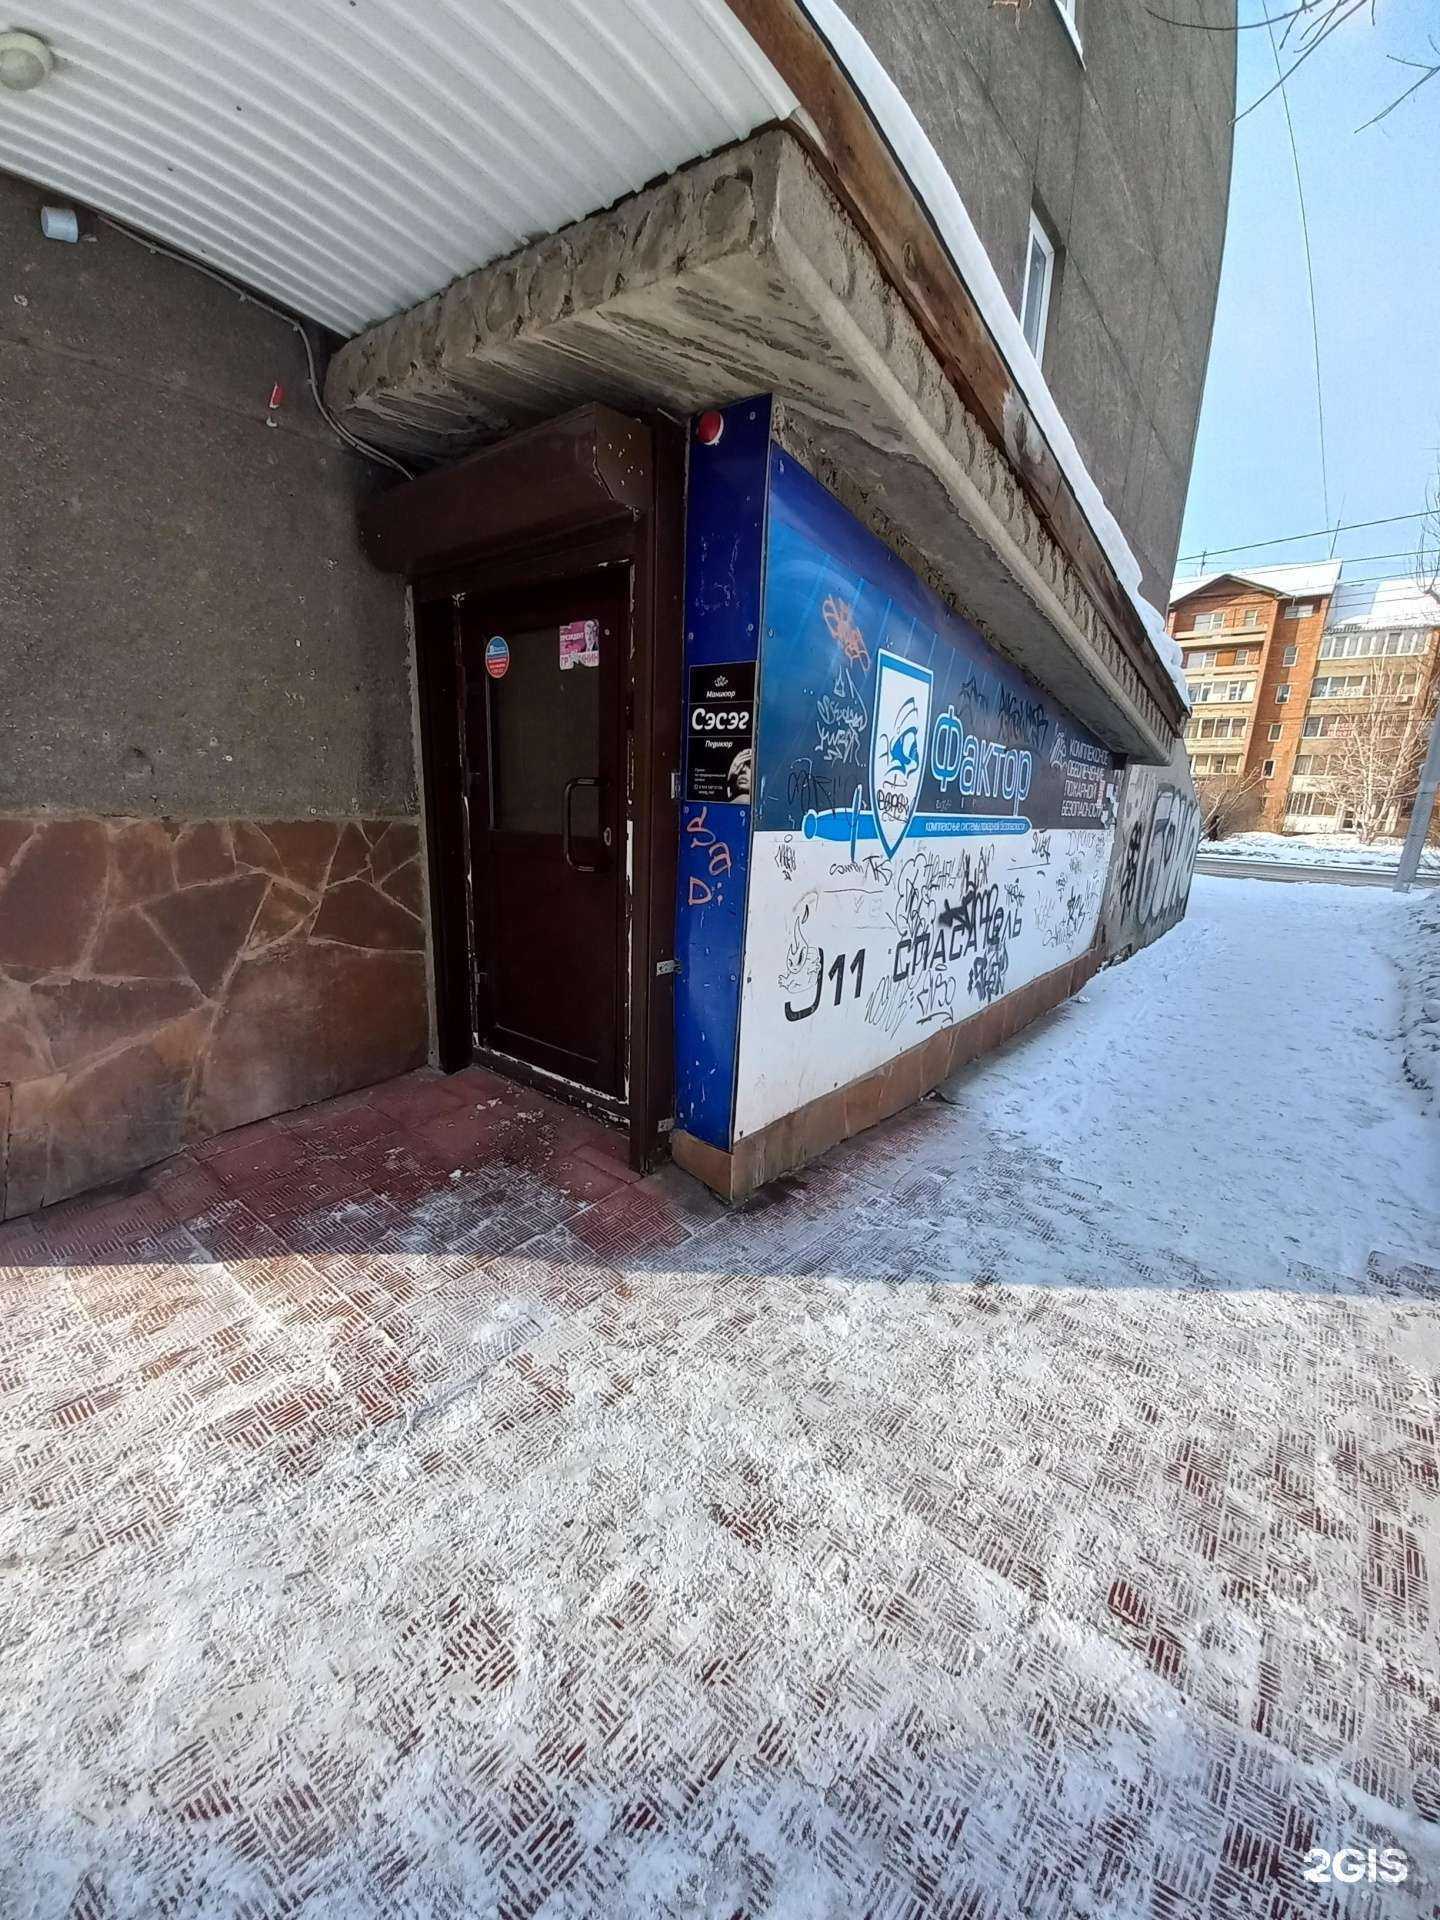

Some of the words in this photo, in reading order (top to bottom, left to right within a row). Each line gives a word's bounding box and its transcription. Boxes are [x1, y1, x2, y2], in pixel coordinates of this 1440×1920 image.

[706, 690, 736, 699] Маникюр
[691, 707, 750, 731] Сэсэг
[705, 739, 733, 749] Педикюр
[931, 704, 1032, 816] Фактор
